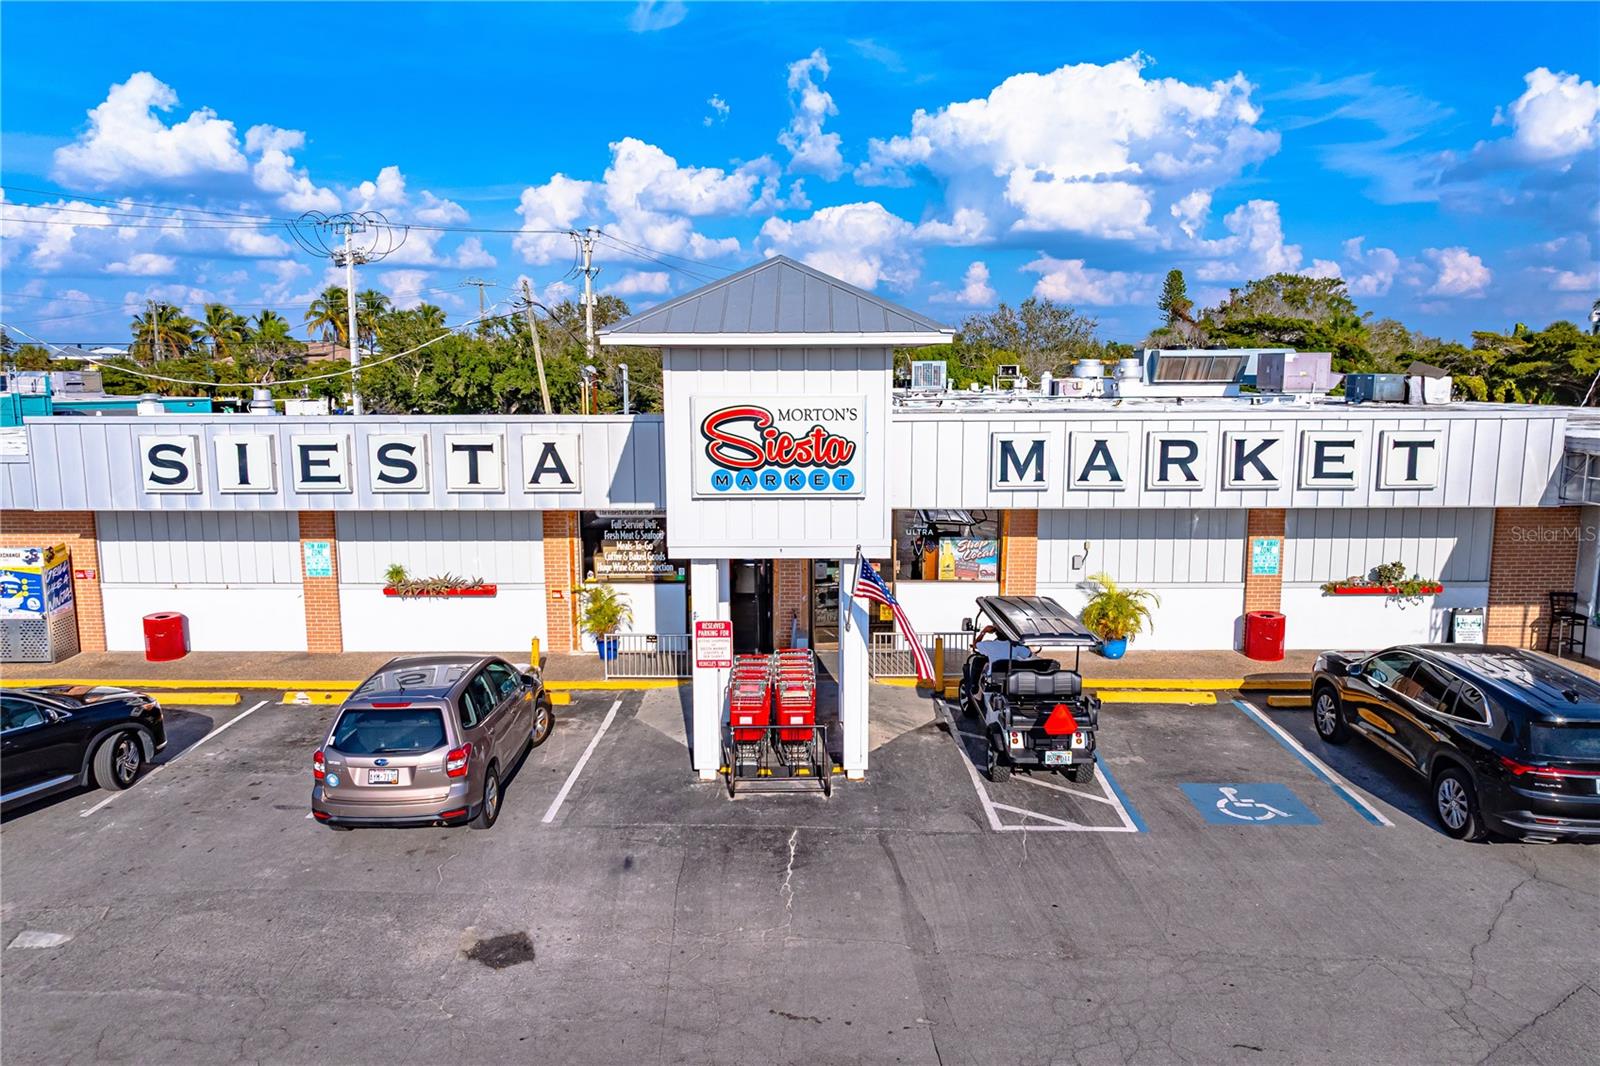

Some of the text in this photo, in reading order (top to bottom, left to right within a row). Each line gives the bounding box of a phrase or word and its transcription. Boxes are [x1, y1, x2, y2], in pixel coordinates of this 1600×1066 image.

[777, 408, 858, 421] MORTON'S
[701, 405, 856, 471] Siesta
[147, 441, 575, 486] SIESTA
[998, 438, 1436, 482] MARKET
[714, 473, 850, 487] MARKET
[604, 530, 665, 540] Fresh Meat & Seafood
[905, 528, 934, 536] ULTRA
[616, 540, 654, 550] Meals-To-Go
[957, 539, 988, 552] Shop
[622, 551, 628, 561] &
[629, 551, 647, 561] Baked
[647, 551, 666, 561] Goods
[962, 546, 995, 562] Local
[598, 562, 674, 573] Huge Wine & Beer Selection
